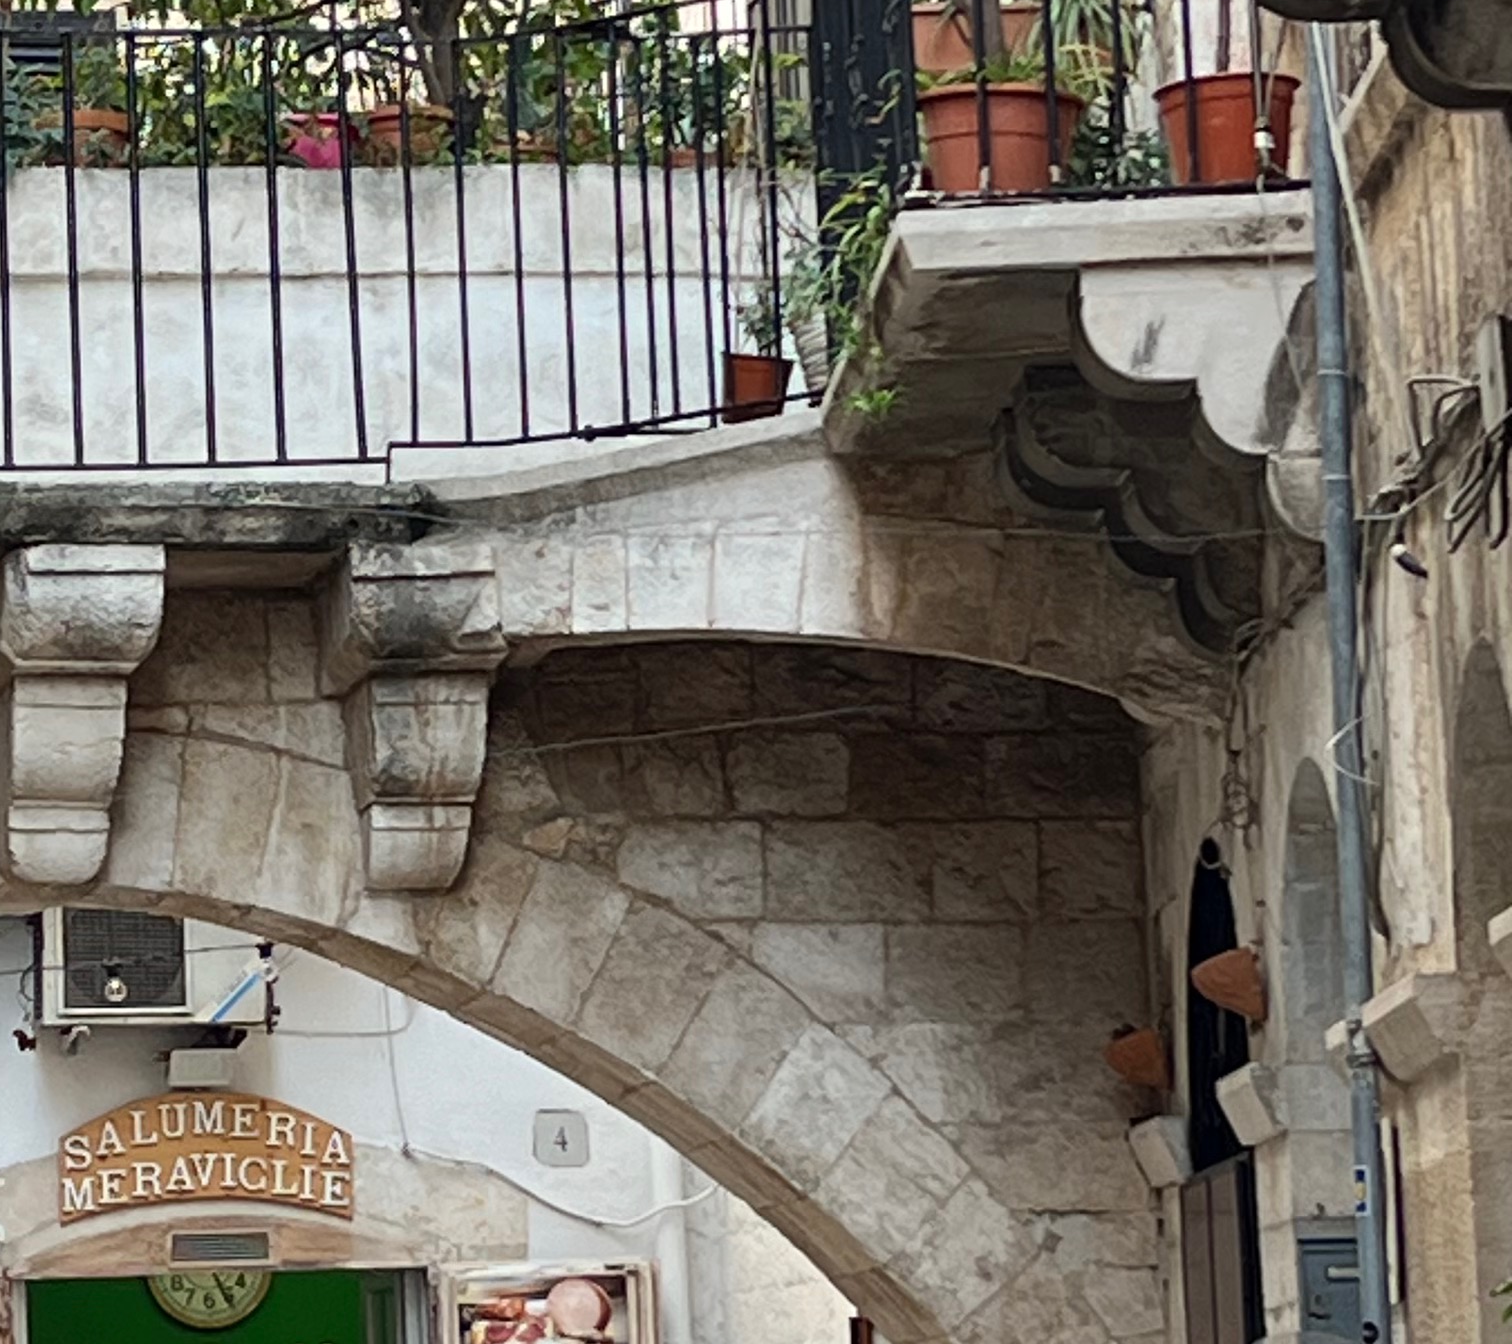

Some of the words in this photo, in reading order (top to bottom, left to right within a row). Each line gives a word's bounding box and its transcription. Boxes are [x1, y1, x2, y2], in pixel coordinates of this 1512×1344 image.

[63, 1100, 351, 1171] SALUMERIA
[552, 1125, 568, 1153] 4
[171, 1274, 184, 1291] 8
[235, 1272, 246, 1288] 4
[184, 1287, 196, 1305] 7
[203, 1292, 216, 1309] 6
